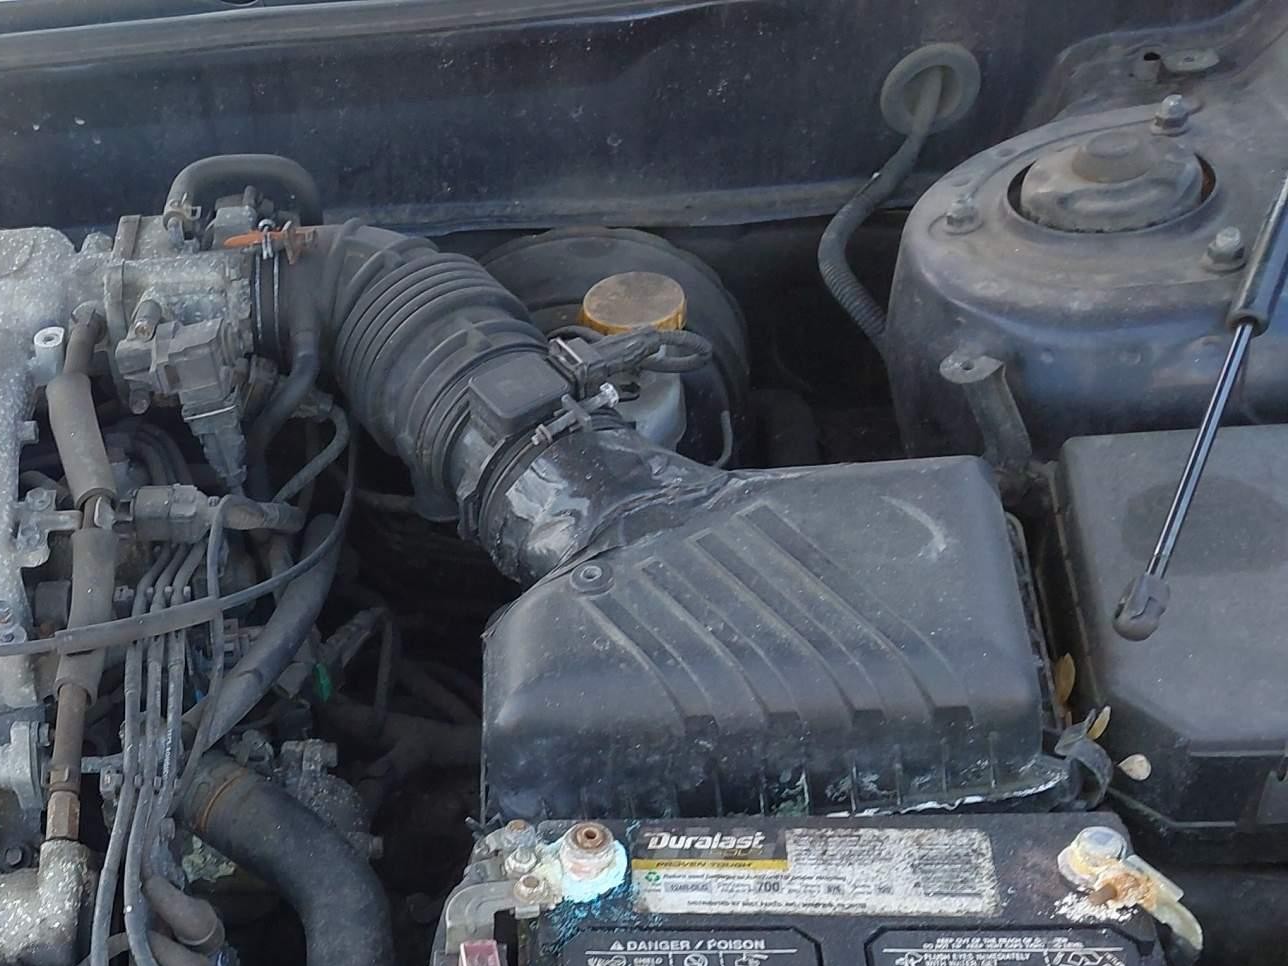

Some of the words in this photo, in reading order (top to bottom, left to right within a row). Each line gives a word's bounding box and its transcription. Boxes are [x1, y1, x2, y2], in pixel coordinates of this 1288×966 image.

[644, 832, 765, 850] Duralast
[757, 881, 780, 893] 700
[626, 940, 690, 951] DANGER
[693, 939, 704, 951] /
[707, 938, 765, 950] POISON
